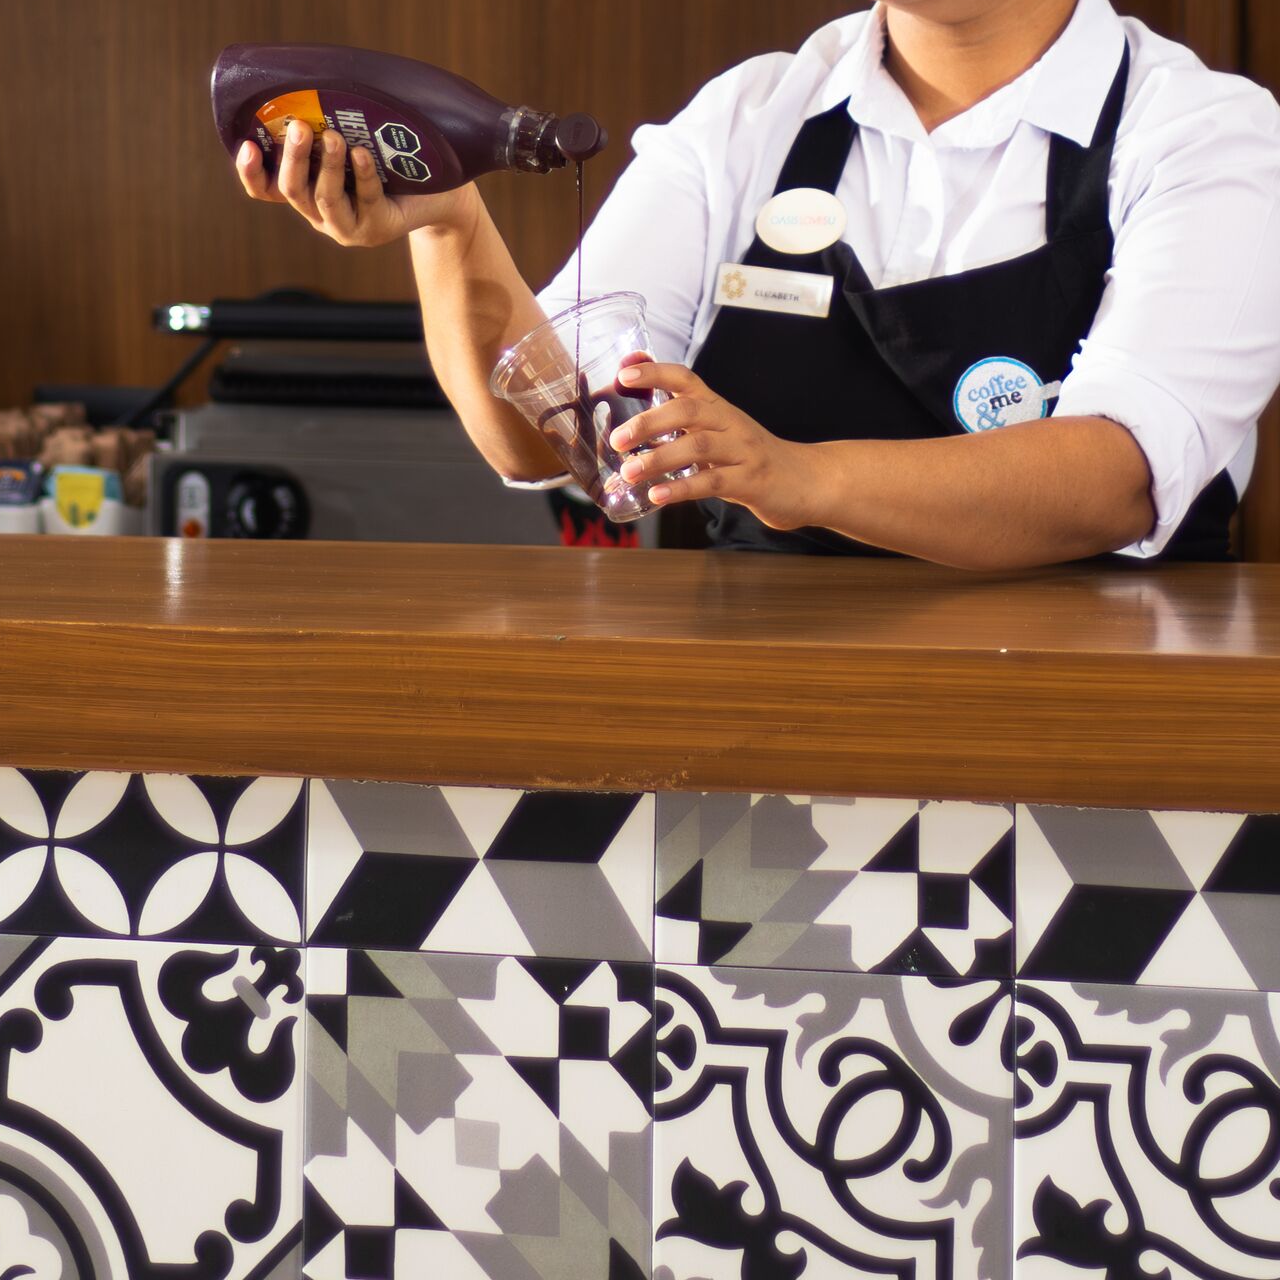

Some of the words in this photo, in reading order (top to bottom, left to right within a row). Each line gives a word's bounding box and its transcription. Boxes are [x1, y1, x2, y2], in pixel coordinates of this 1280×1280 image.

[968, 372, 1027, 402] coffee
[989, 391, 1023, 410] me
[975, 401, 1008, 430] &
